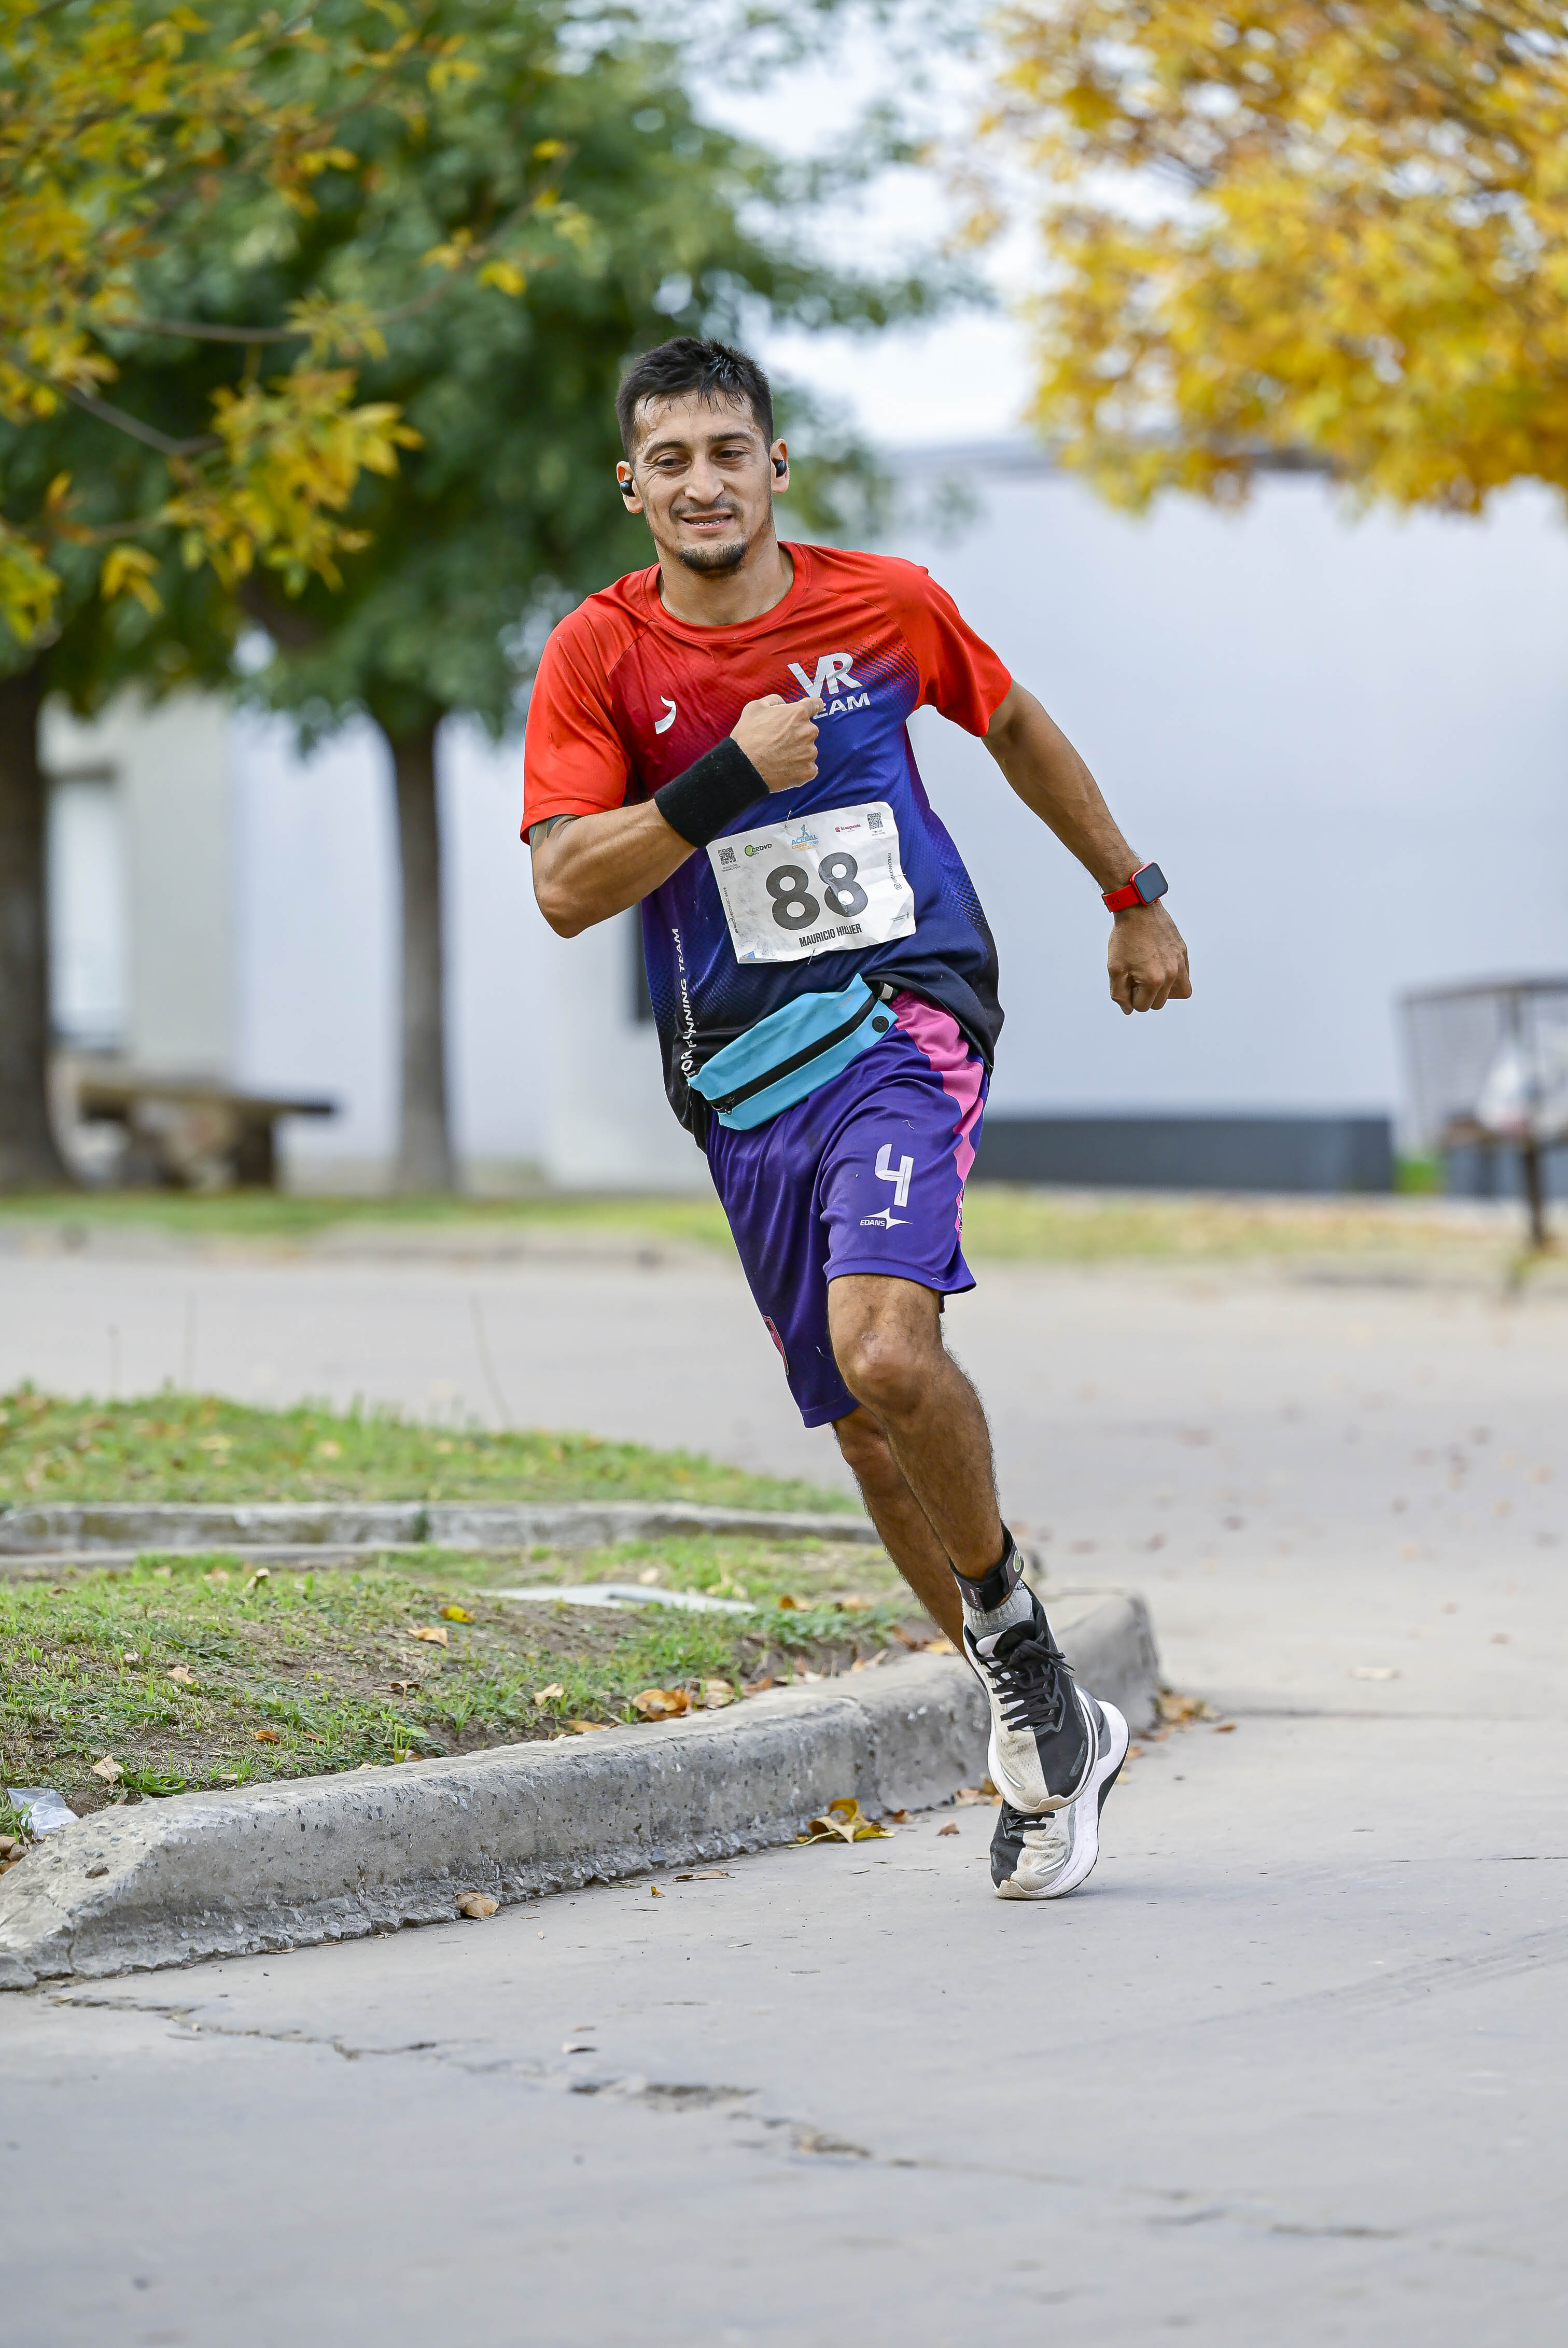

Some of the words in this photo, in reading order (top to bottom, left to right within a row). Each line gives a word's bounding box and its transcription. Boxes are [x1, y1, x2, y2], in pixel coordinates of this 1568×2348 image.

[787, 652, 863, 698] VR
[813, 693, 871, 720] EAM
[766, 852, 869, 930] 88
[671, 929, 685, 973] TEAM
[799, 928, 836, 947] MAURICIO
[874, 1143, 914, 1208] 4
